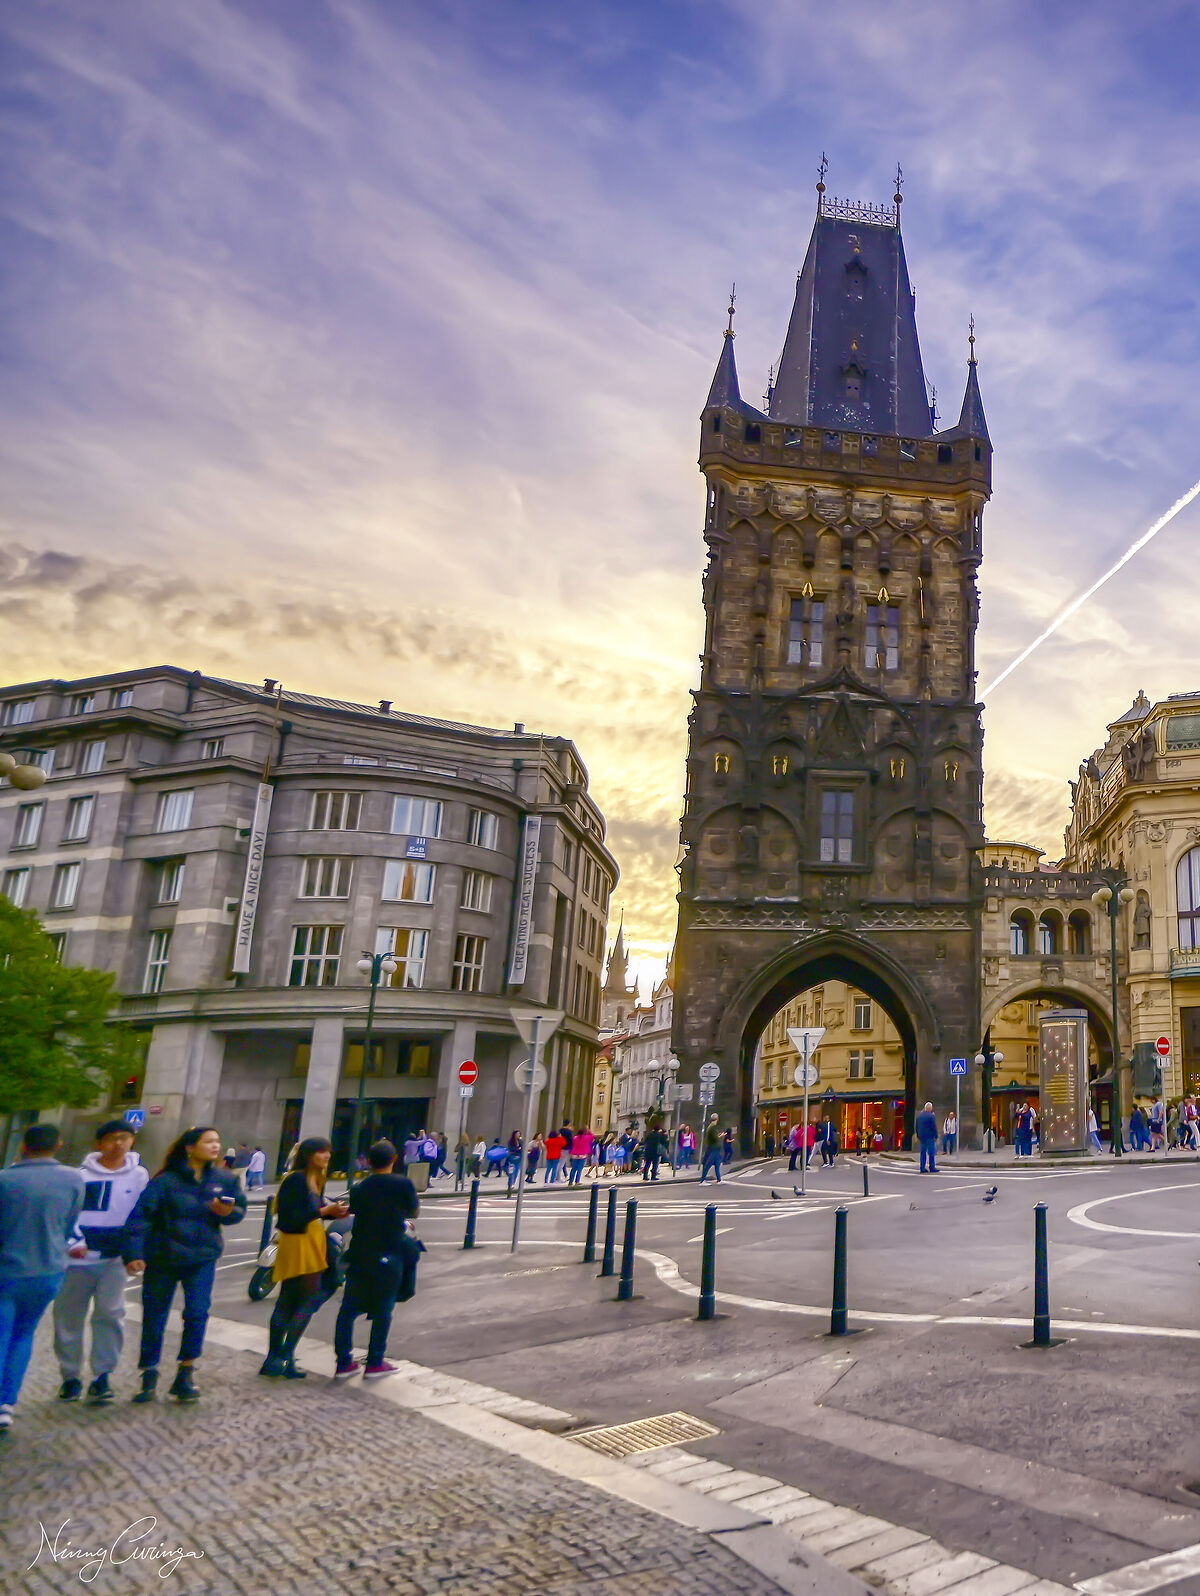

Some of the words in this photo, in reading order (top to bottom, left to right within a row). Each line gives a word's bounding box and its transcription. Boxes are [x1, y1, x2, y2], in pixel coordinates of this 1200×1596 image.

[525, 840, 537, 886] SUCCESS
[247, 865, 260, 894] NICE
[246, 900, 255, 909] A
[520, 891, 531, 916] REAL
[239, 911, 254, 946] HAVE
[515, 918, 529, 970] CREATING
